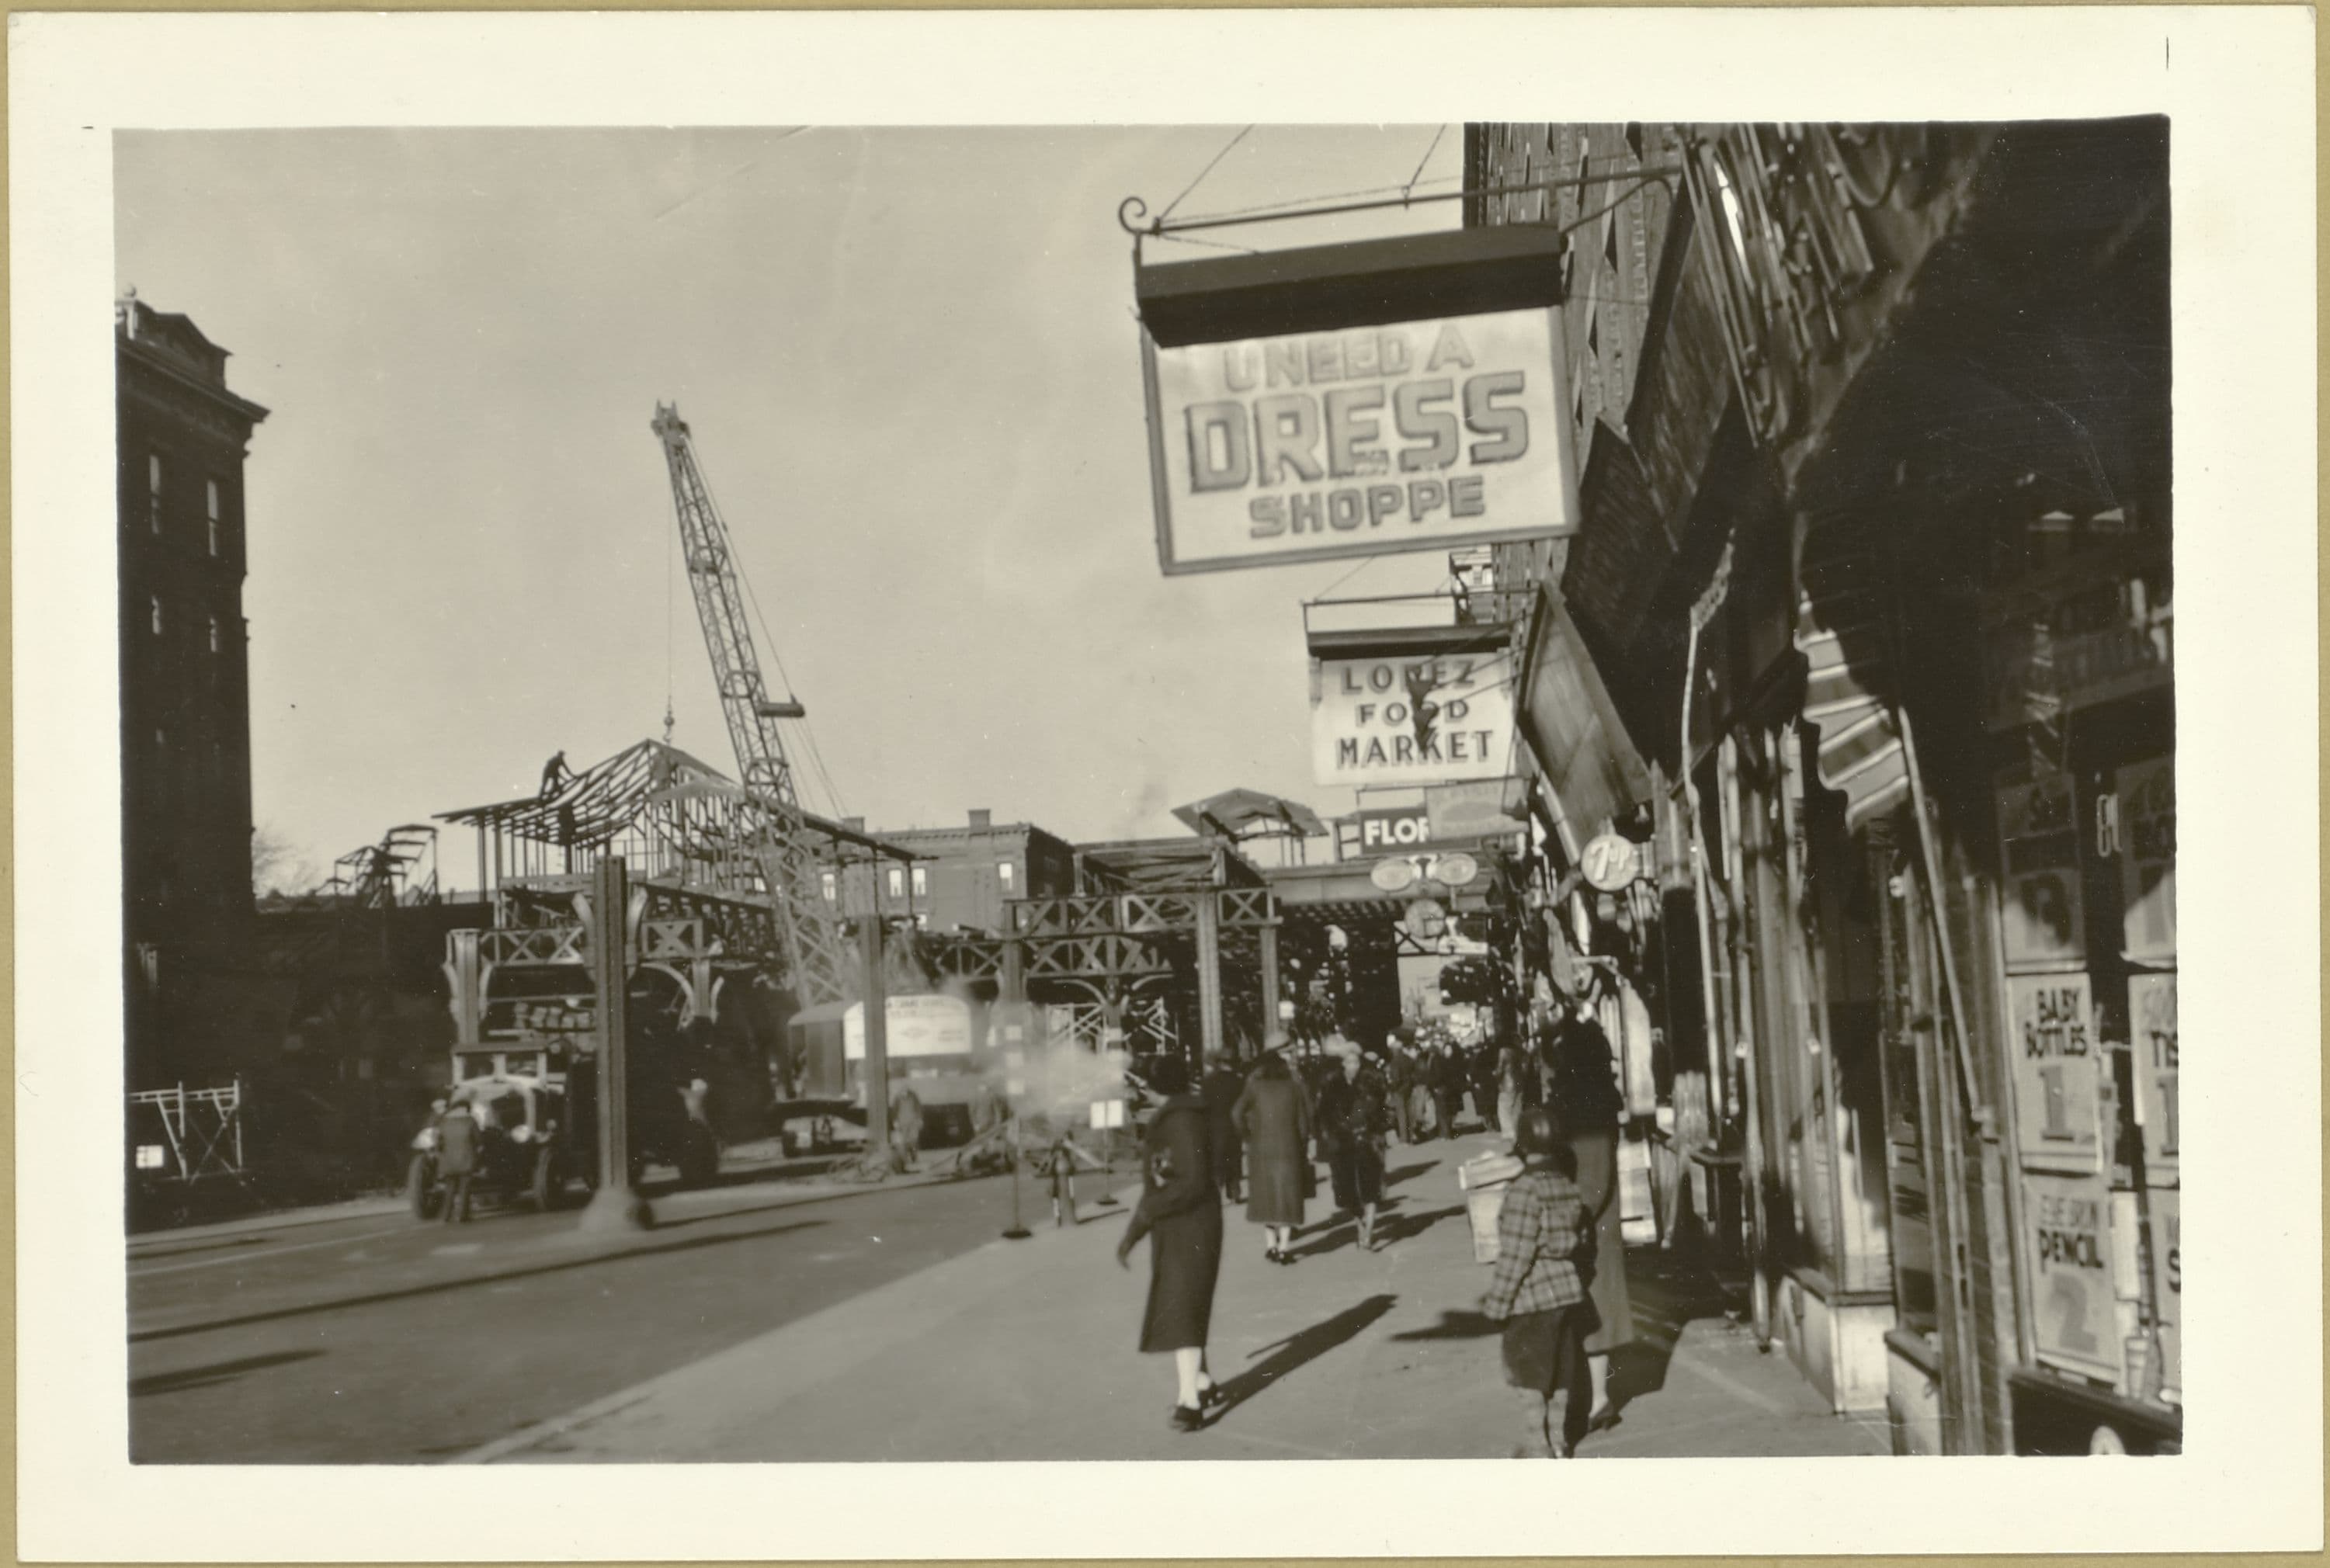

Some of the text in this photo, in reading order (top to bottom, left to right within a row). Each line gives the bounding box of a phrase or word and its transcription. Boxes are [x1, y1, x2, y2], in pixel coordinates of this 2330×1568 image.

[1424, 324, 1474, 372] A
[1184, 370, 1530, 493] DRESS
[1249, 475, 1485, 539] SHOPPE
[1342, 660, 1478, 695] LOEZ
[1336, 730, 1492, 769] MARKET
